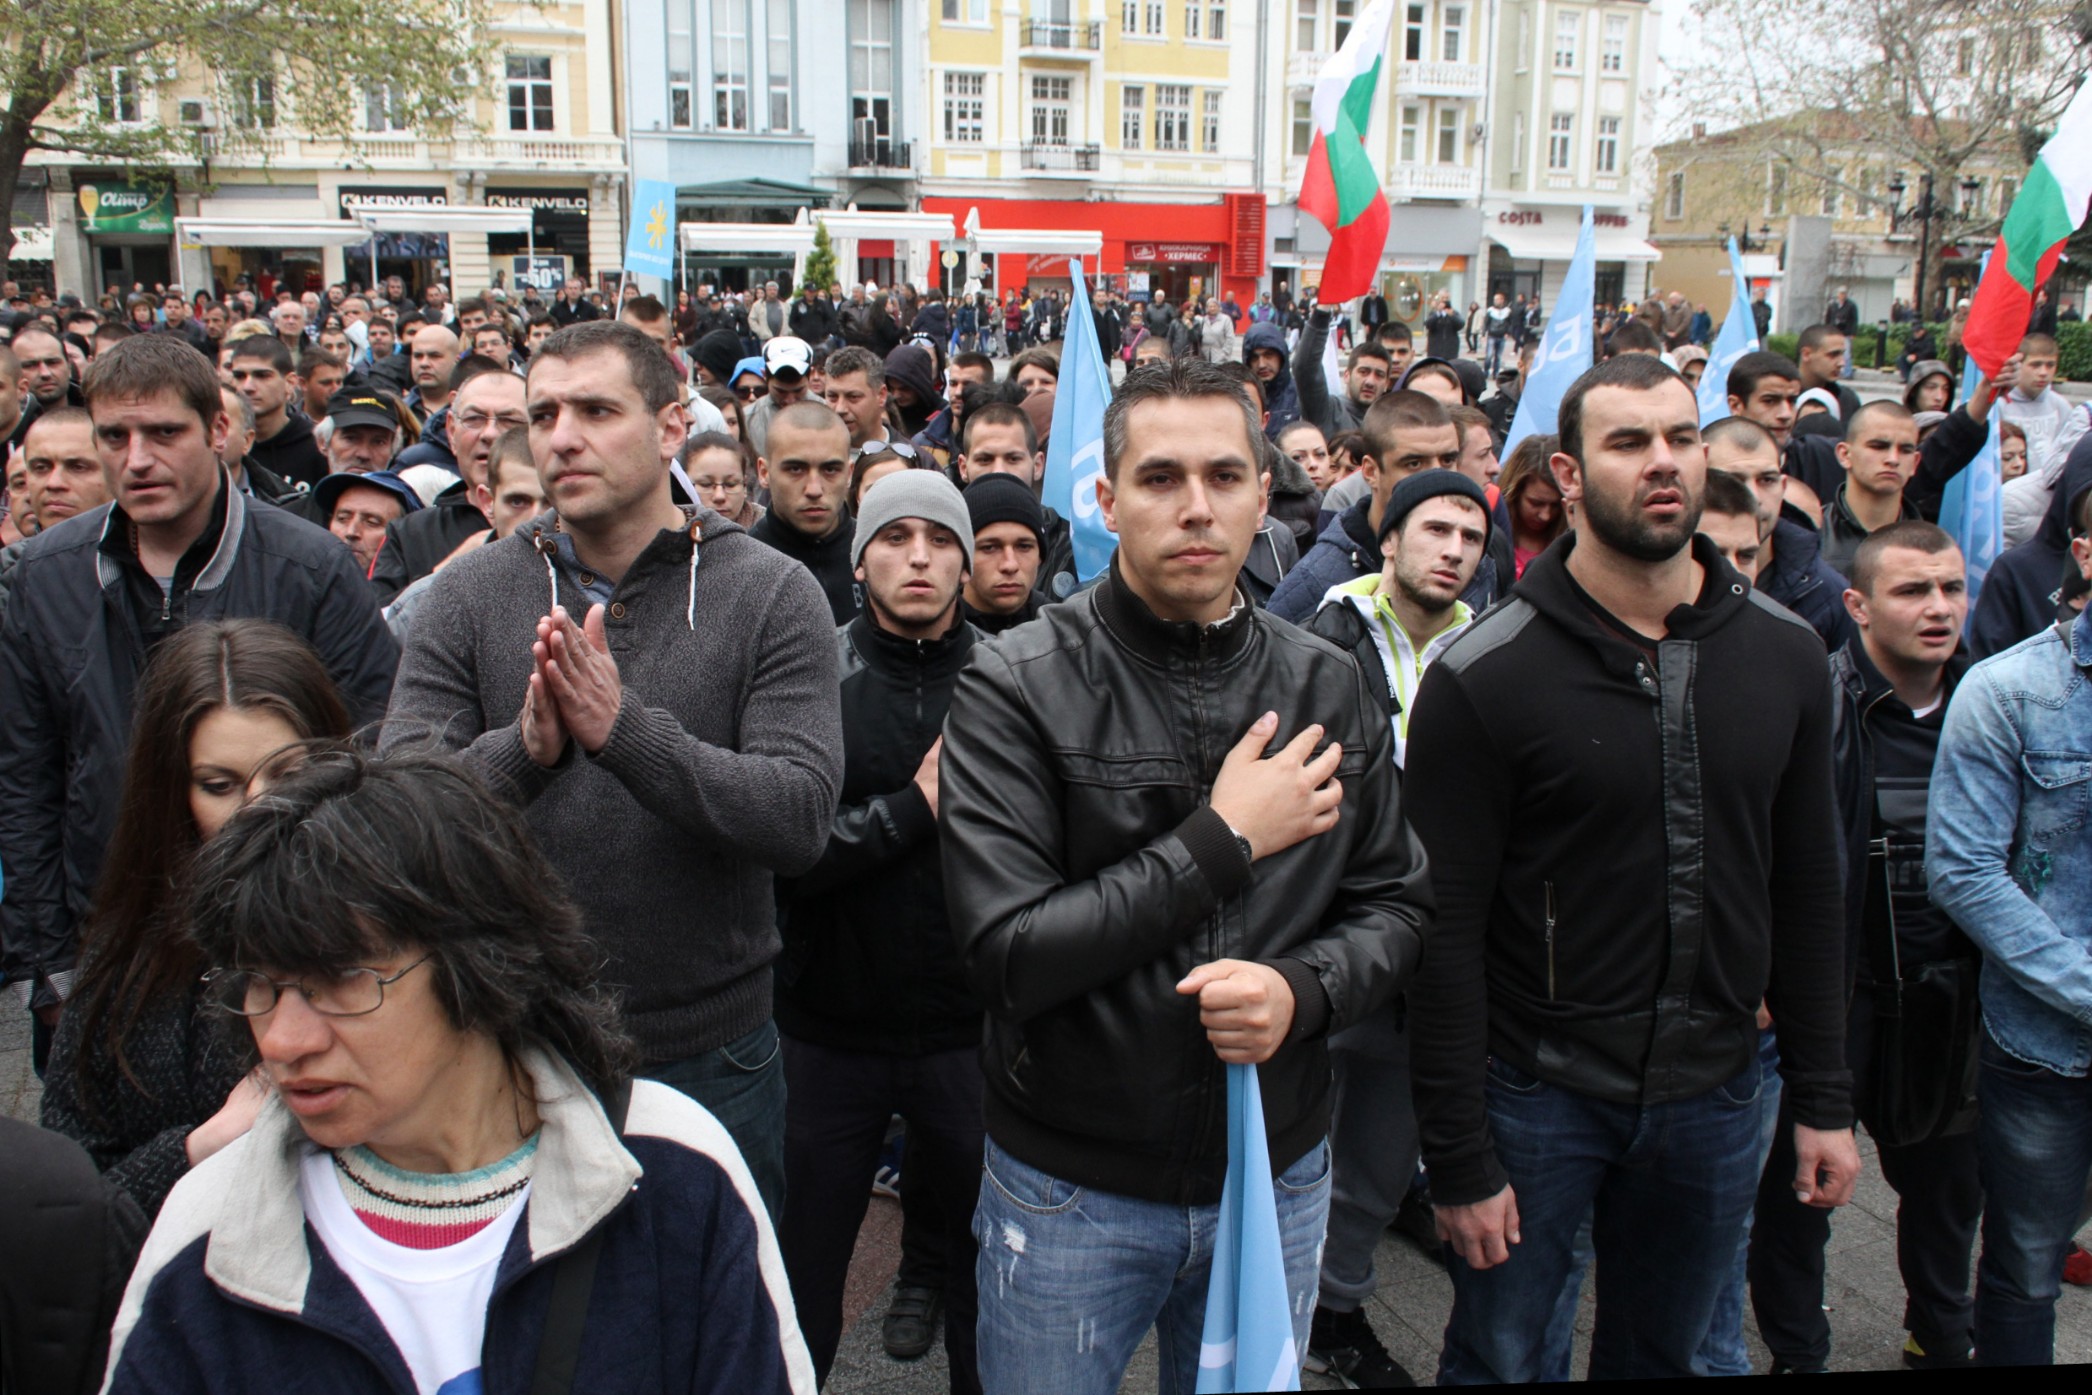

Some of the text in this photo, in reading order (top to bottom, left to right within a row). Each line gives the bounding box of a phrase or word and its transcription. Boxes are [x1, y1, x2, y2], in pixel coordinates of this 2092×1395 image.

[362, 195, 446, 206] KENVELO
[508, 196, 588, 208] KENVELO
[1499, 211, 1542, 226] COSTA
